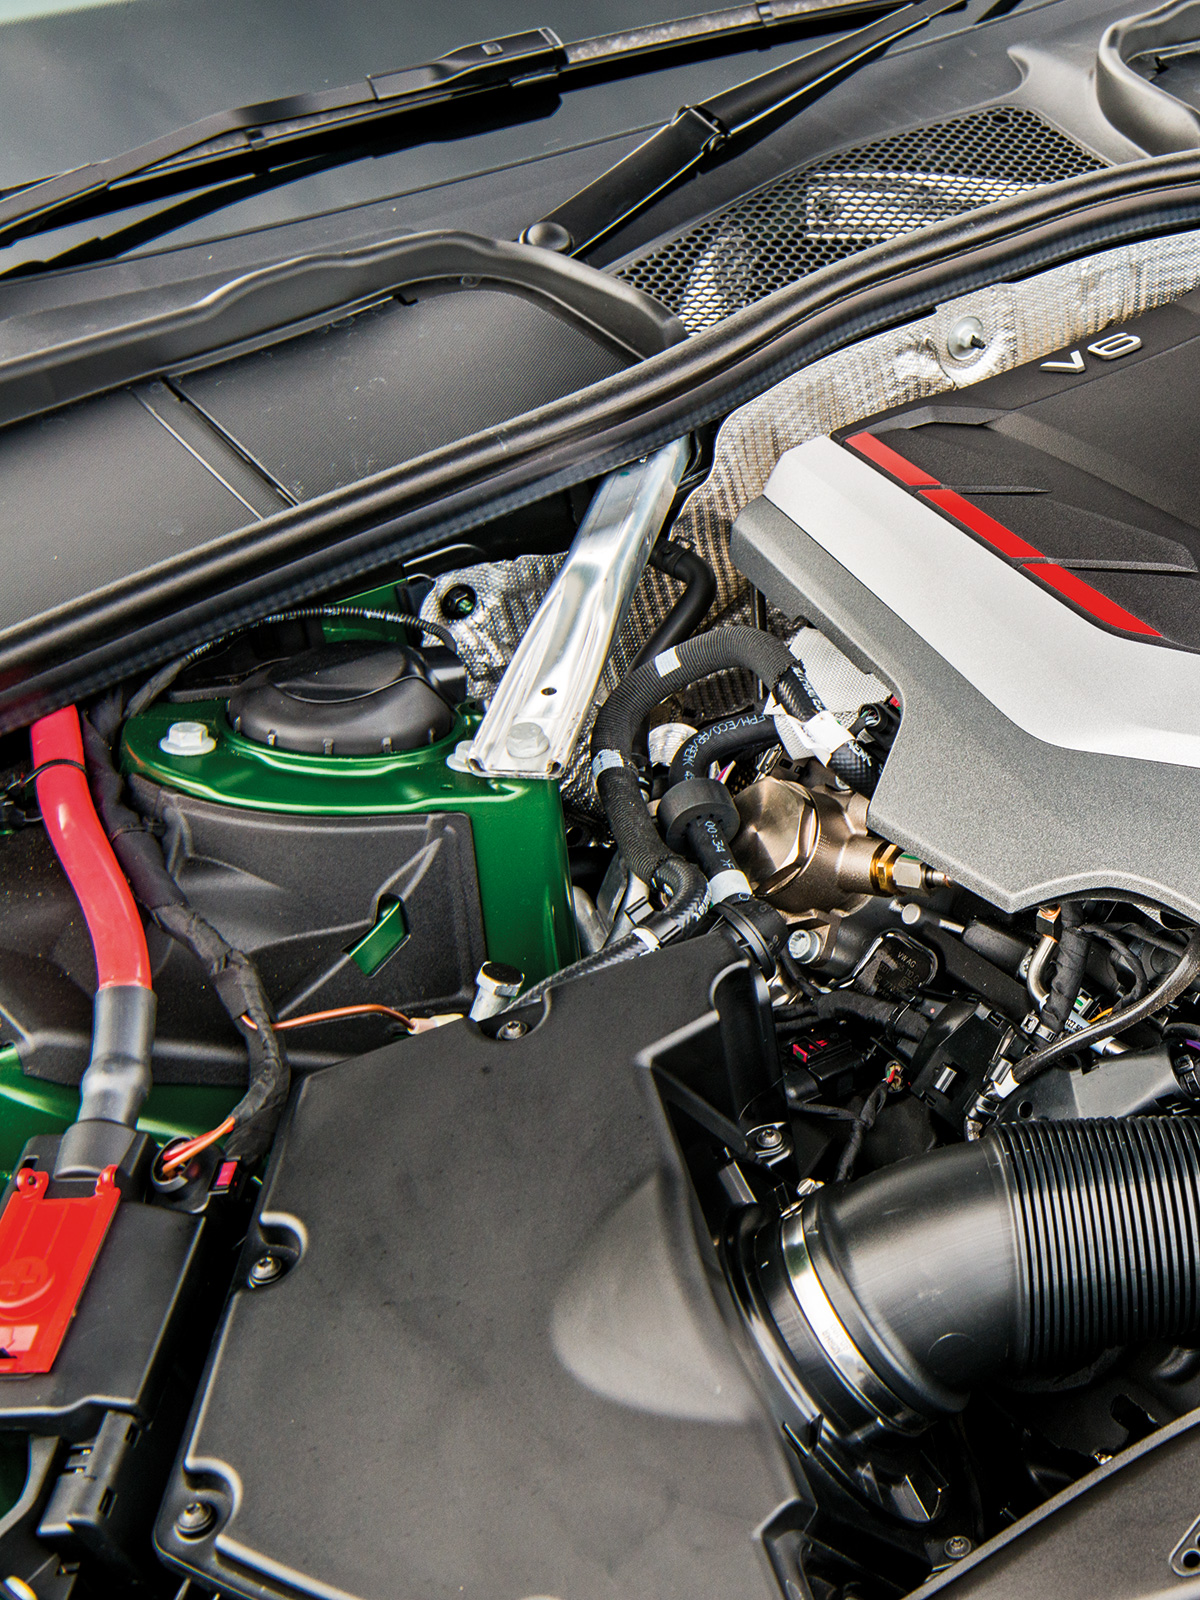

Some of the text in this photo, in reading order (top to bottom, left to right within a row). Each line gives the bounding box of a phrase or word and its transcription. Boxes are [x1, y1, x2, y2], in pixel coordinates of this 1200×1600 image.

[1039, 331, 1143, 374] V6
[897, 951, 917, 969] VW AG
